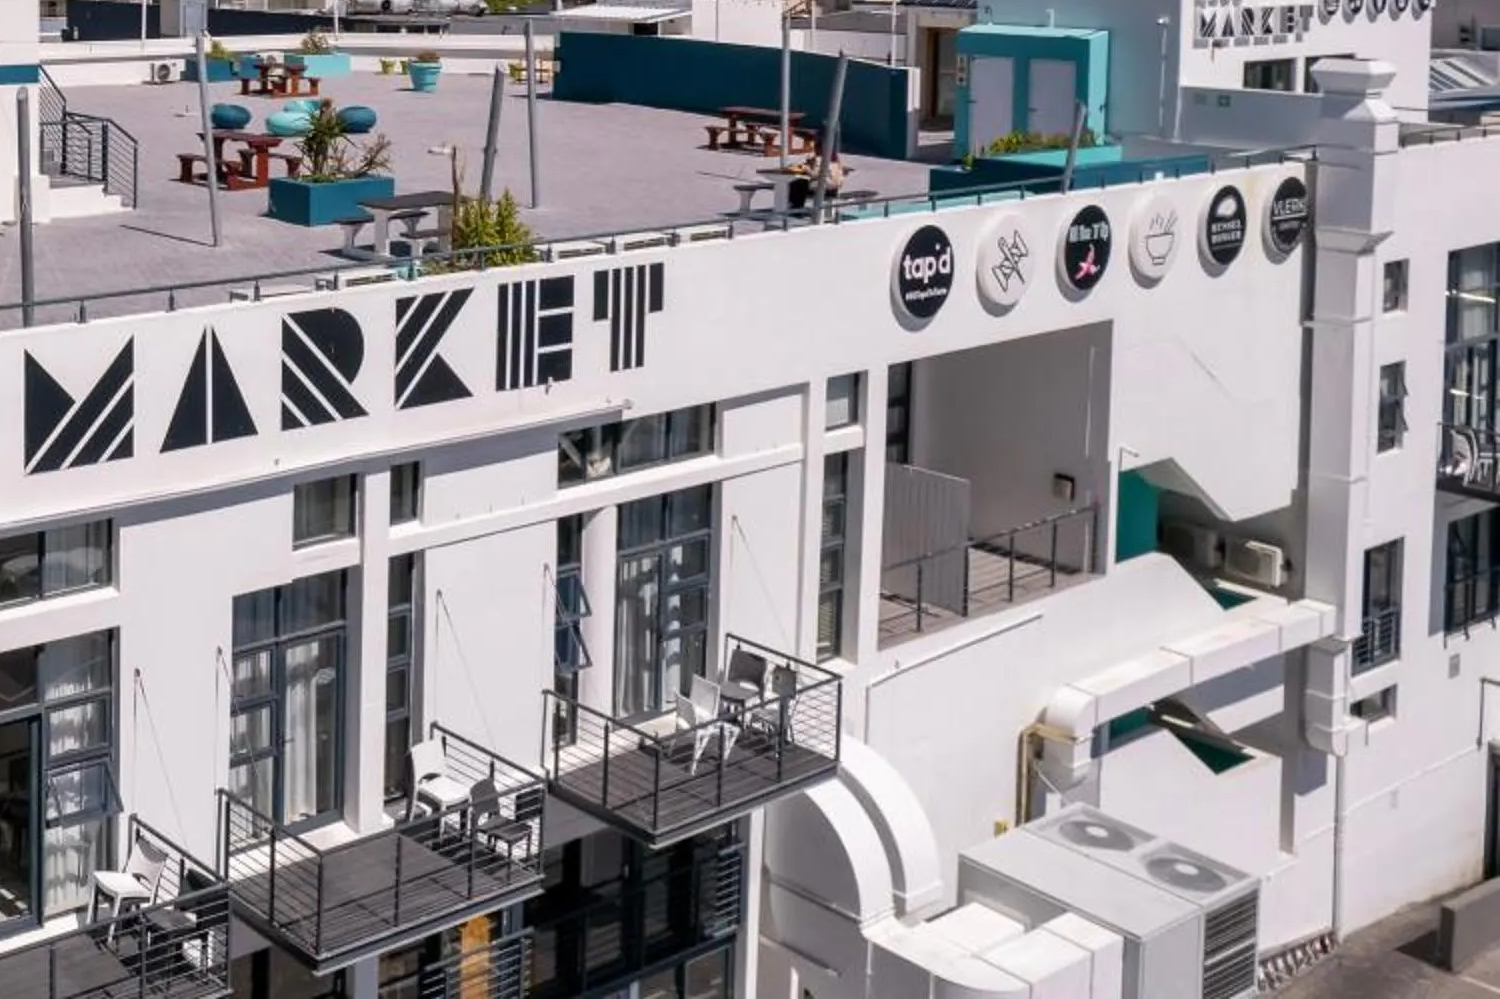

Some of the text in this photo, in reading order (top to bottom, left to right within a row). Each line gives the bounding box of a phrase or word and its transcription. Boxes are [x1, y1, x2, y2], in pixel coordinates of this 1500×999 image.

[1199, 5, 1314, 37] MARKET
[903, 242, 951, 284] tap'd
[25, 263, 663, 474] MARKET
